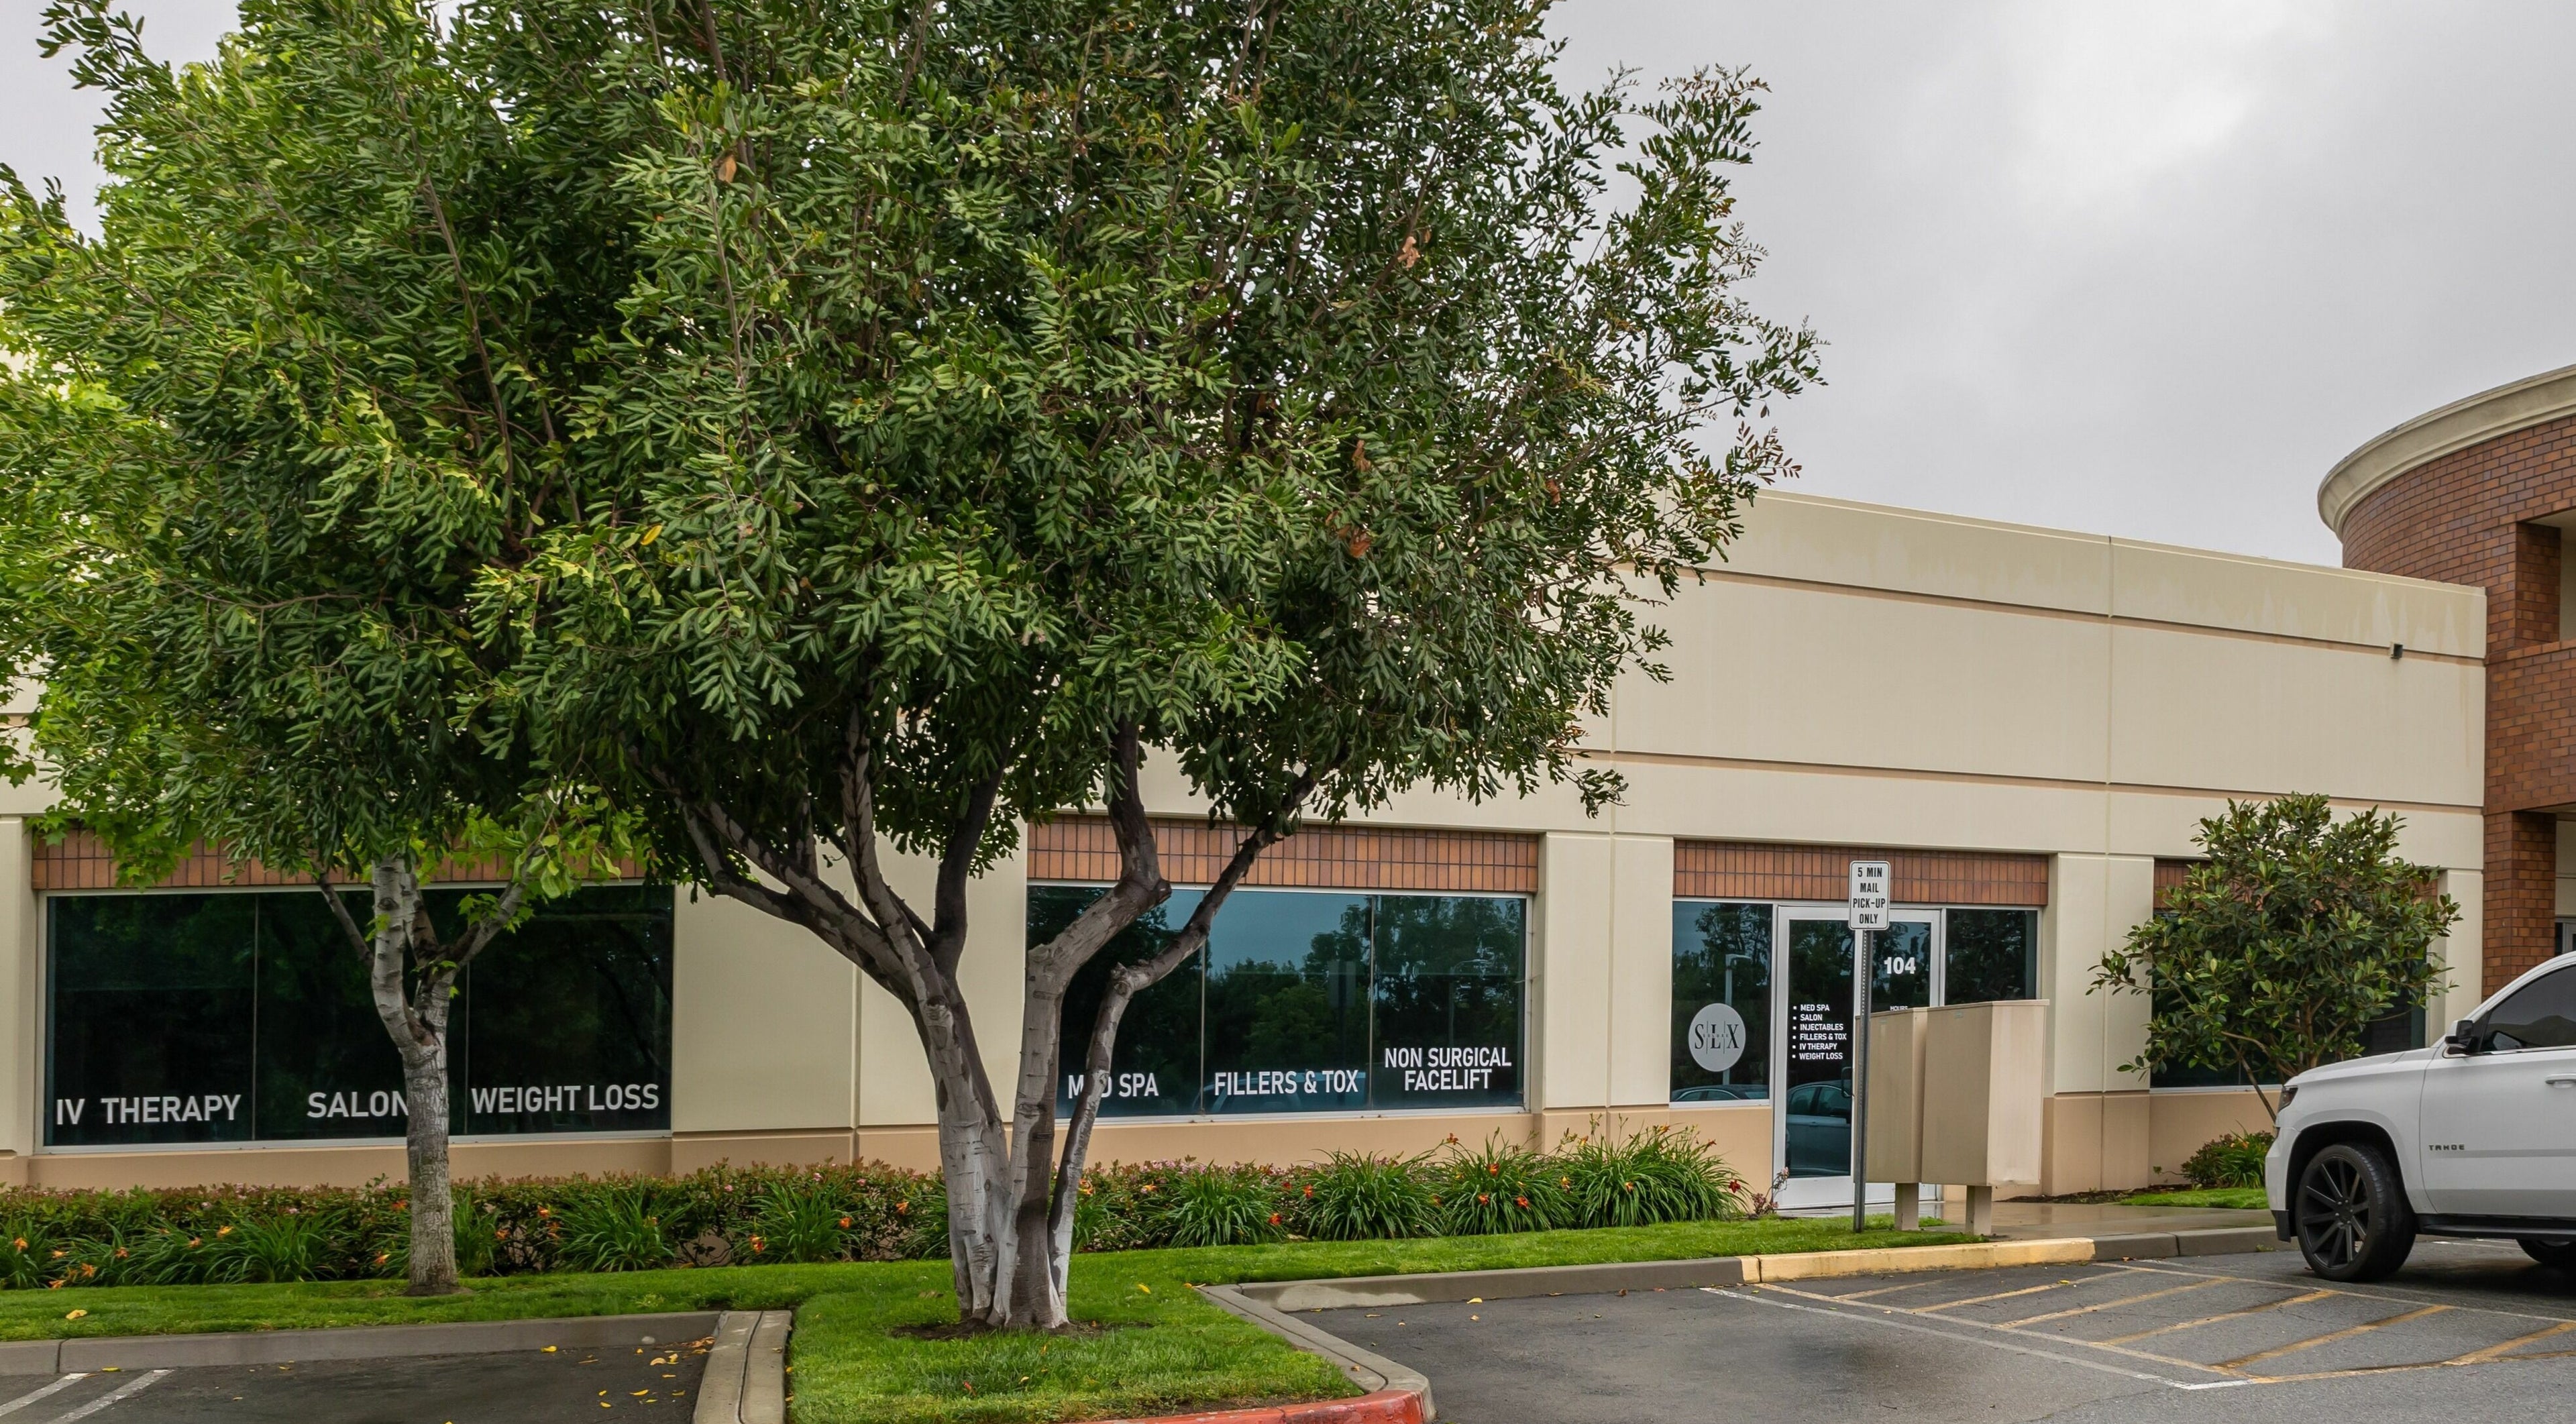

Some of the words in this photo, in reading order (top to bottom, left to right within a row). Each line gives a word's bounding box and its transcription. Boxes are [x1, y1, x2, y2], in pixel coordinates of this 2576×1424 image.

[1858, 867, 1863, 877] 5
[1866, 867, 1882, 878] MIN
[1860, 882, 1879, 893] MAIL
[1853, 897, 1886, 909] PICK-UP
[1859, 913, 1878, 924] ONLY
[1884, 956, 1916, 975] 104
[1800, 1003, 1815, 1011] MED
[1800, 1014, 1823, 1022] SALON
[1800, 1023, 1844, 1031] INJECTABLES
[1807, 1042, 1837, 1050] THERAPY
[1385, 1047, 1422, 1068] NON
[1428, 1047, 1512, 1068] SURGICAL
[1825, 1052, 1843, 1060] LOSS
[1118, 1073, 1159, 1097] SPA
[1214, 1071, 1297, 1096] FILLERS
[1303, 1071, 1318, 1094] &
[1322, 1069, 1358, 1093] TOX
[1405, 1068, 1493, 1091] FACELIFT
[307, 1091, 409, 1117] SALON
[471, 1085, 582, 1113] WEIGHT
[588, 1083, 659, 1111] LOSS
[56, 1098, 85, 1125] IV
[101, 1094, 241, 1124] THERAPY
